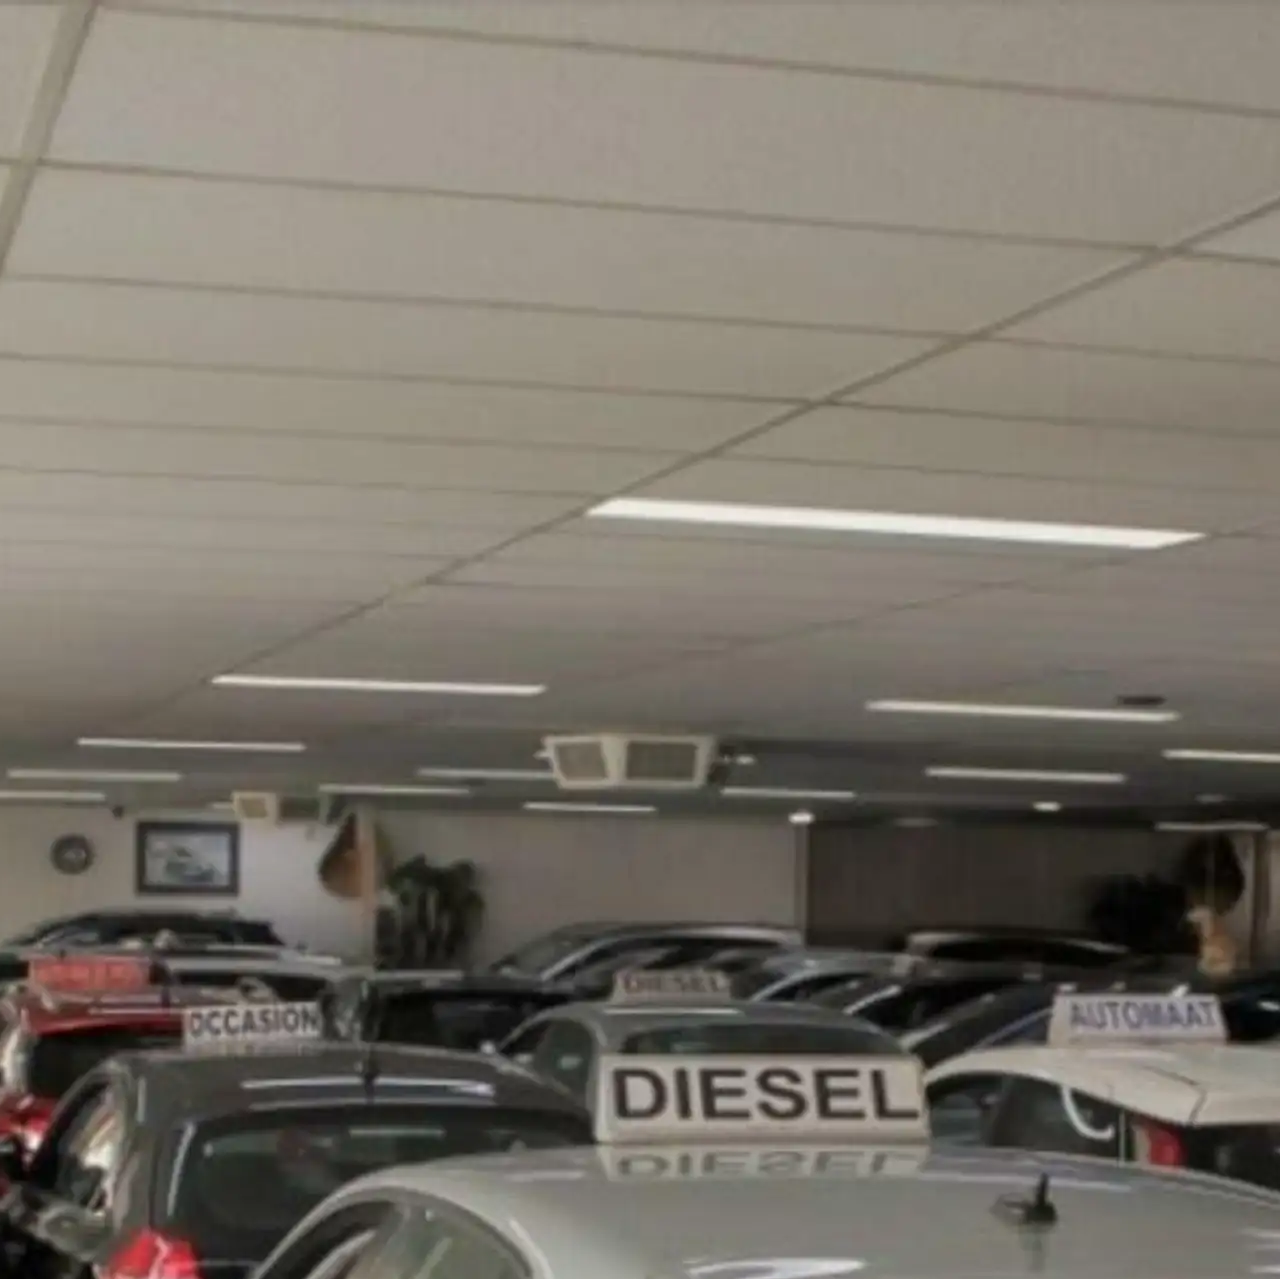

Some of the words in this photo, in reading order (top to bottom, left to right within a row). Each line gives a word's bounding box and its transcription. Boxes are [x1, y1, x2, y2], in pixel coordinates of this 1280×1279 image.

[190, 1007, 318, 1037] OCCASION
[1072, 1001, 1217, 1029] AUTOMAAT
[614, 1067, 920, 1121] DIESEL
